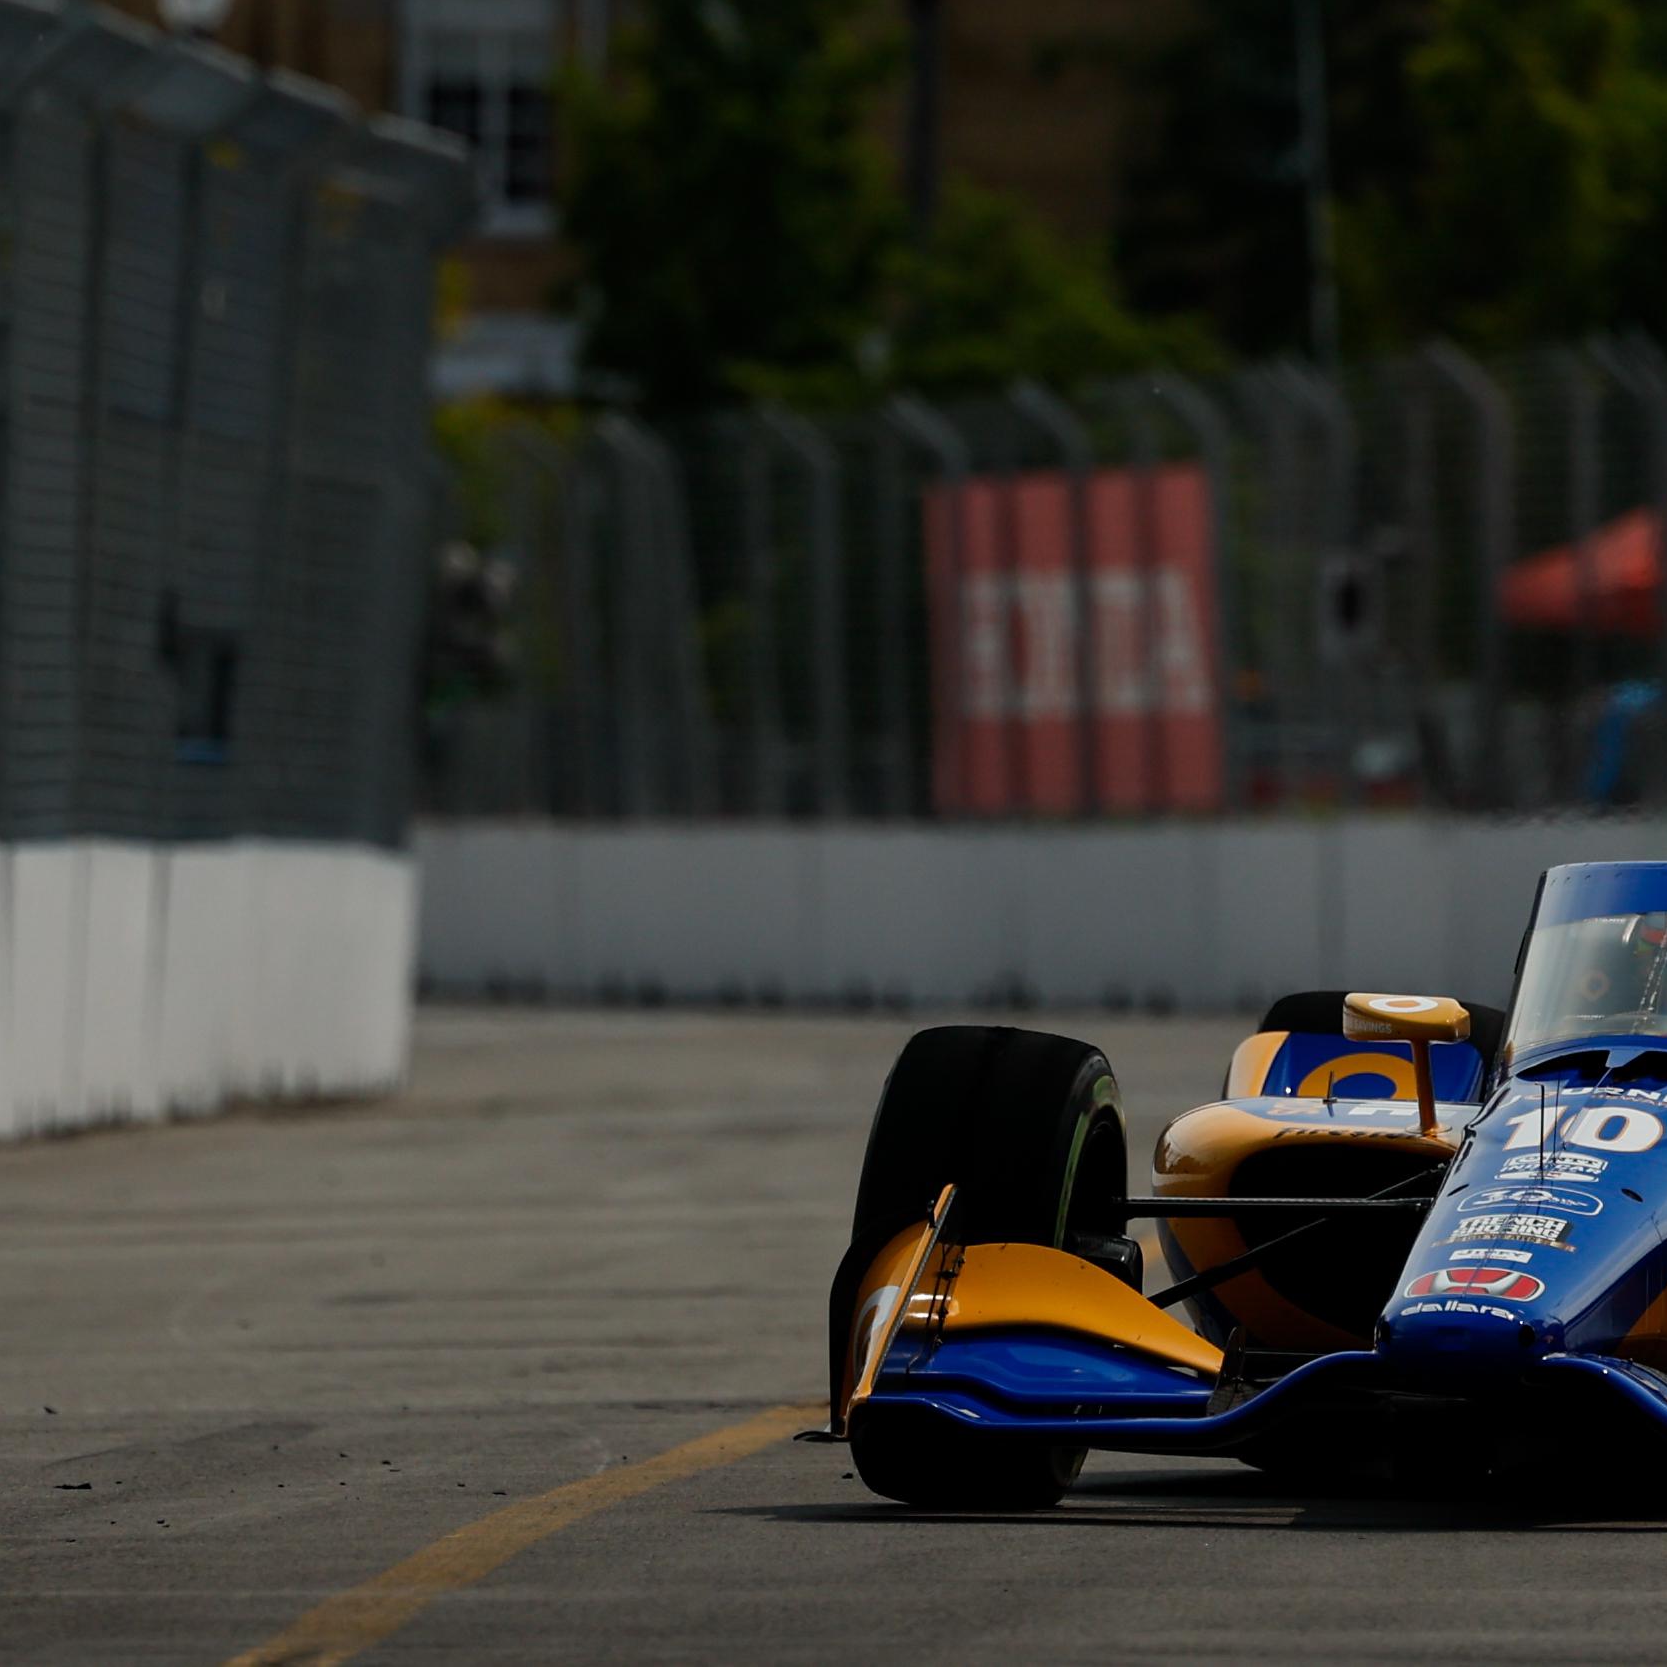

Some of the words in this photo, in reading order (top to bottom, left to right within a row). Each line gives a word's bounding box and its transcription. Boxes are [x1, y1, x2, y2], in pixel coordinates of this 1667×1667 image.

[1502, 1104, 1665, 1153] 10
[1461, 1215, 1567, 1231] TRENCH
[1400, 1300, 1514, 1321] dallara
